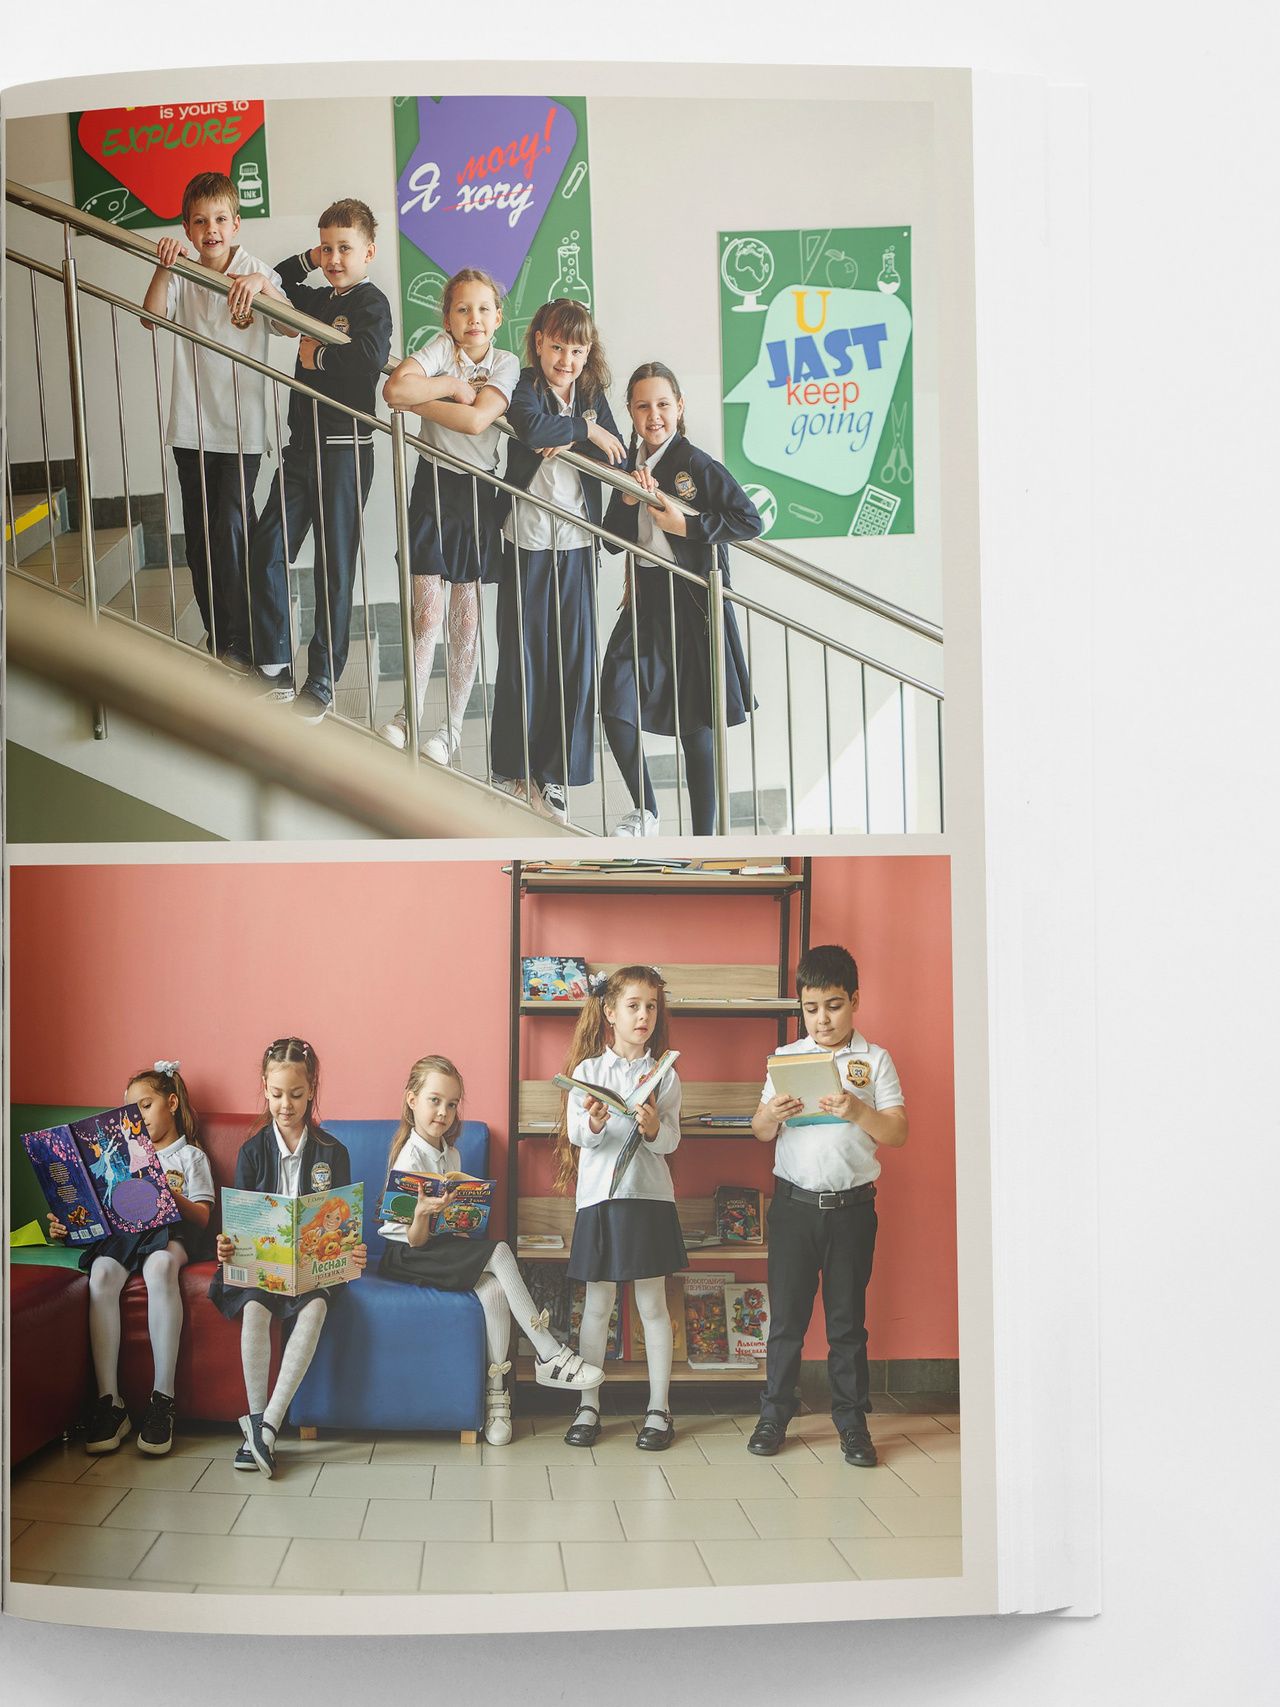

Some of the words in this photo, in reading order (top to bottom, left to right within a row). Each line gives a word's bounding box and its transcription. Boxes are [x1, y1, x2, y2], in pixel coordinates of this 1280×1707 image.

[159, 105, 174, 119] is
[178, 101, 228, 120] yours
[231, 99, 250, 113] to
[101, 116, 242, 157] EXPLORE
[456, 107, 557, 185] могу!
[243, 190, 257, 199] INK
[400, 162, 442, 215] Я
[455, 181, 535, 228] хочу
[791, 290, 832, 334] U
[765, 322, 889, 388] JAST
[786, 376, 860, 411] keep
[785, 405, 873, 456] going
